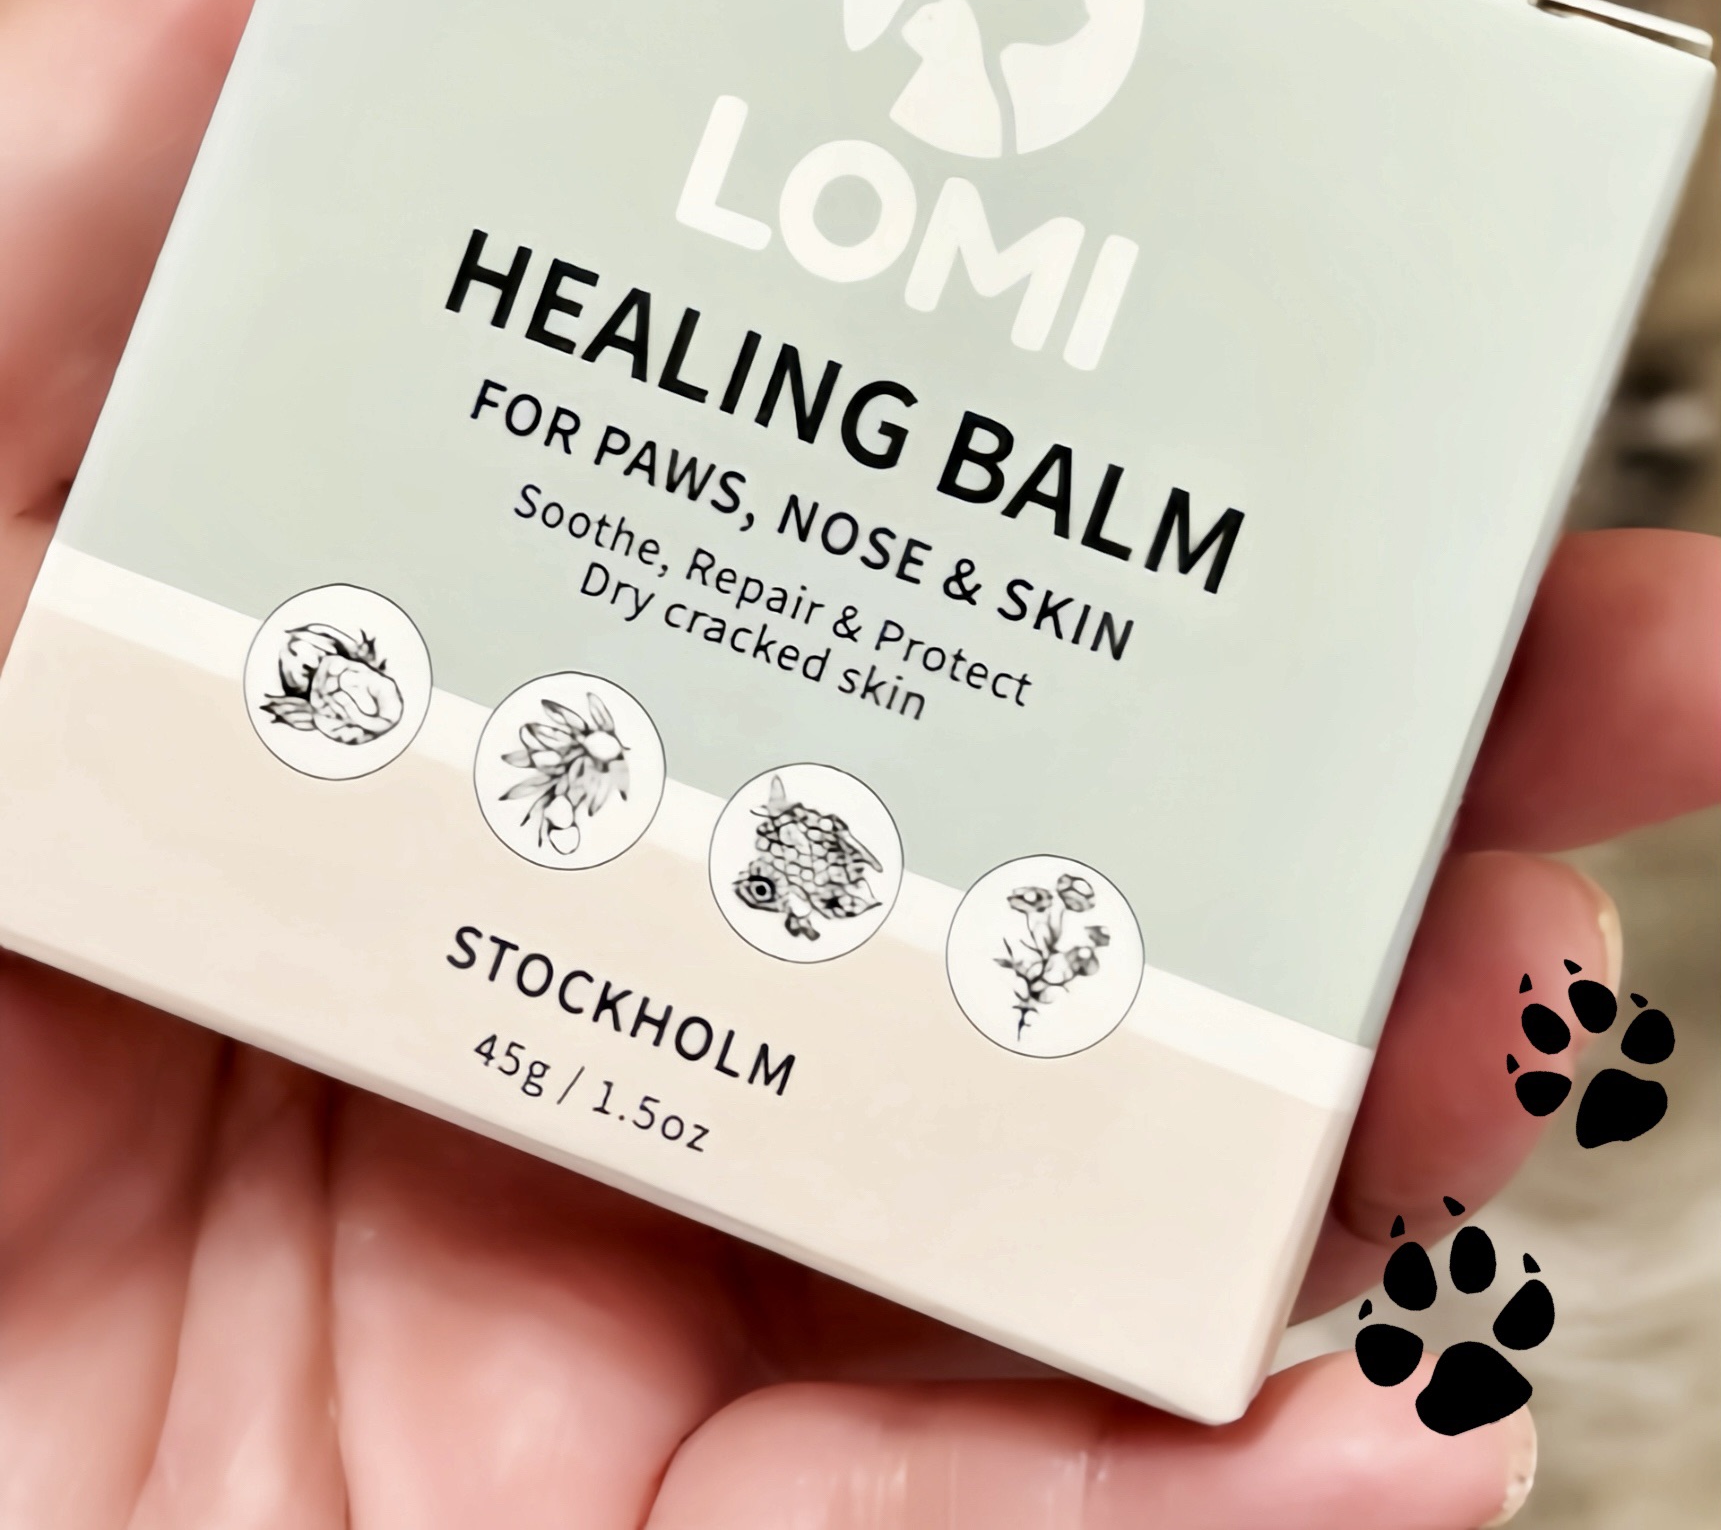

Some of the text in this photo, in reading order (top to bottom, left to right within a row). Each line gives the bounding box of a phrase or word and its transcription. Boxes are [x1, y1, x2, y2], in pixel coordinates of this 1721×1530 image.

[675, 95, 1139, 371] LOMI
[443, 227, 1246, 595] HEALING BALM
[470, 378, 1135, 661] FOR PAWS, NOSE & SKIN
[513, 483, 1033, 707] Soothe, Repair & Protect
[580, 561, 926, 721] Dry cracked skin
[446, 925, 796, 1097] STOCKHOLM
[474, 1034, 710, 1153] 45g / 1.5oz
